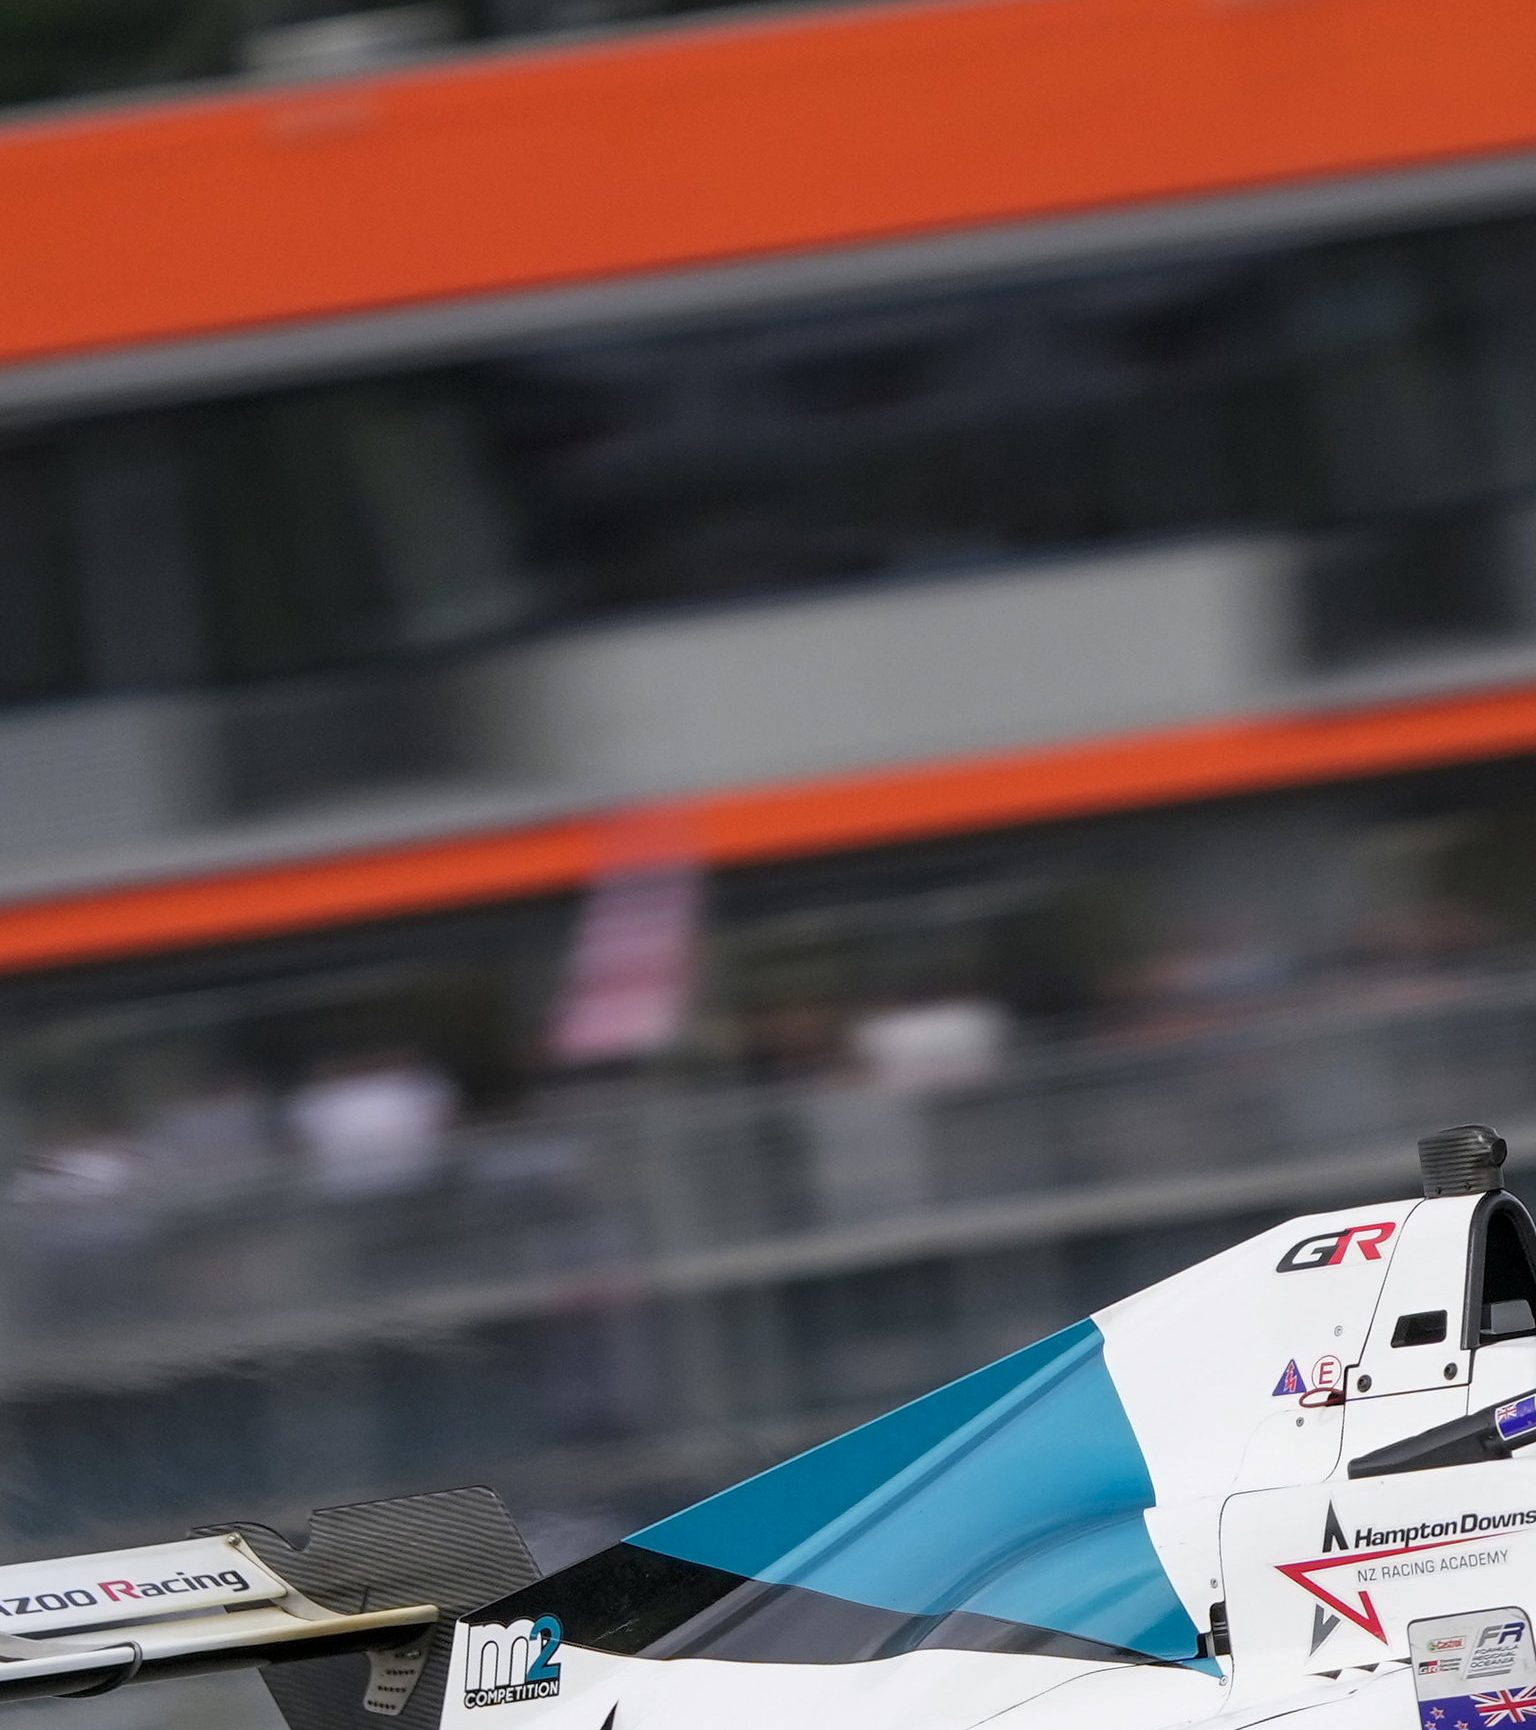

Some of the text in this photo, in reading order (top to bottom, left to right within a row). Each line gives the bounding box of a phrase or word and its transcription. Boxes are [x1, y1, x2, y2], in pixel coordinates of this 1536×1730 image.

[1276, 1222, 1396, 1273] GR
[1319, 1362, 1334, 1384] E
[1354, 1520, 1458, 1549] Hampton
[1358, 1550, 1509, 1583] NZ RACING ACADEMY
[98, 1569, 251, 1602] Racing
[1477, 1621, 1525, 1647] FR
[464, 1680, 560, 1709] COMPETITION
